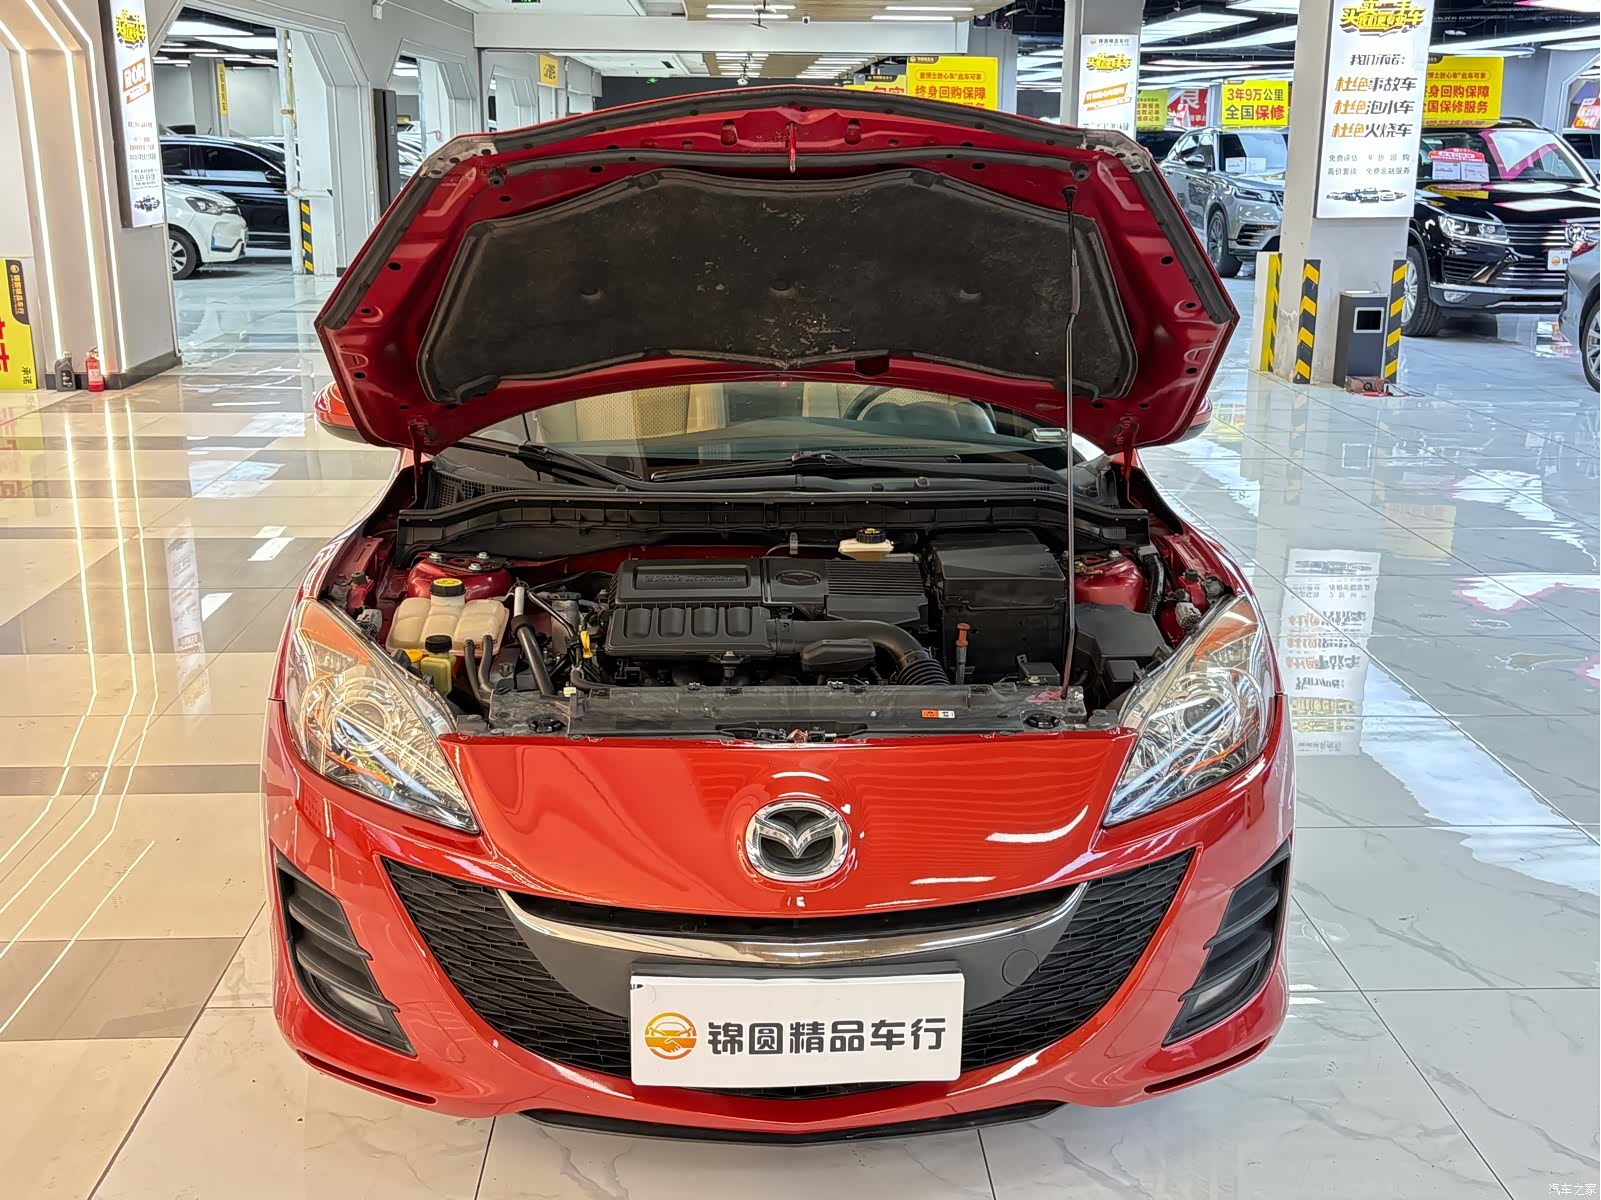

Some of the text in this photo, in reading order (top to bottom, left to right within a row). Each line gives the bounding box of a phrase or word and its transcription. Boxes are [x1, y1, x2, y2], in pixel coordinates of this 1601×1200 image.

[915, 84, 986, 100] 终身回购保障
[1335, 76, 1418, 92] 杜绝事故车
[1227, 88, 1284, 101] 3年9万公里
[1225, 104, 1285, 121] 全国保修
[1333, 99, 1415, 115] 杜绝泡水车
[1331, 123, 1413, 138] 杜绝火烧车
[707, 1017, 946, 1055] 锦圆精品车行
